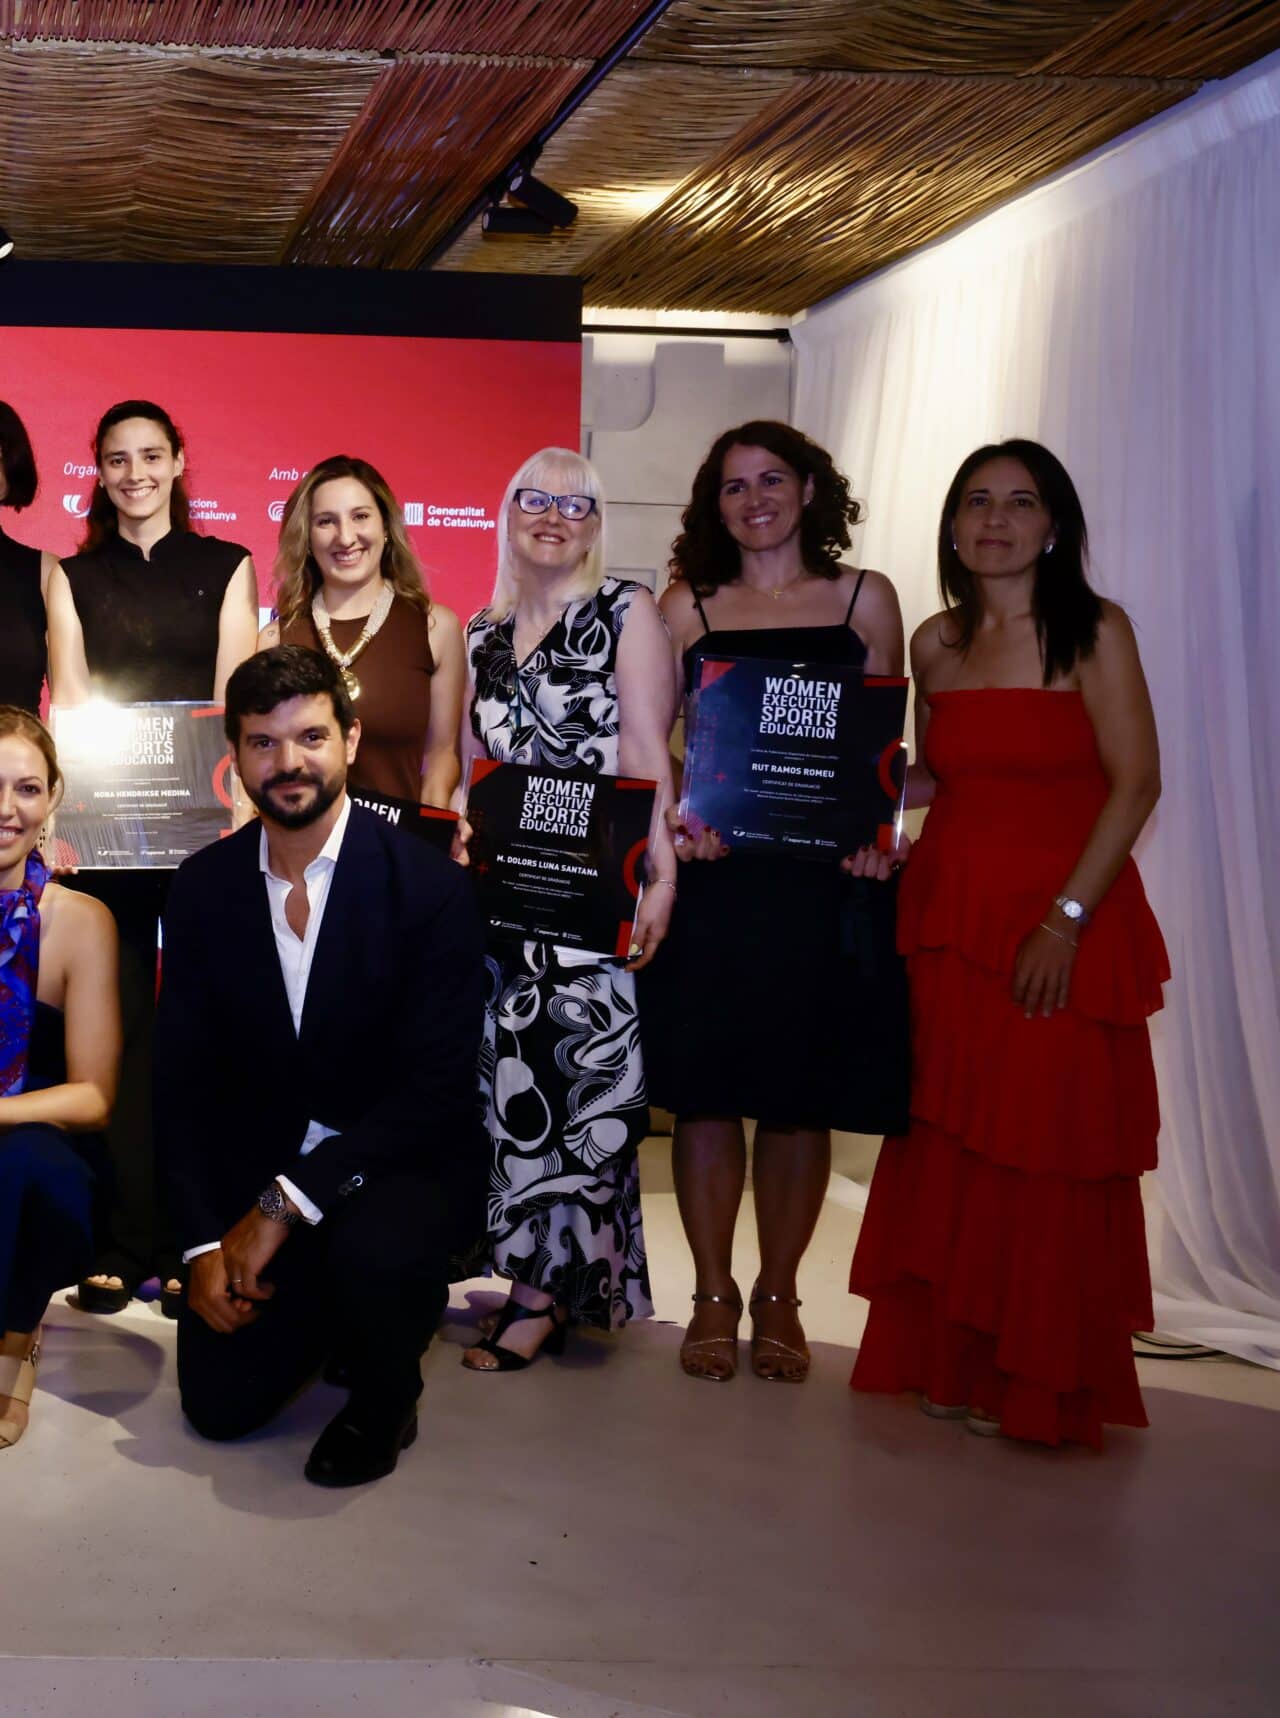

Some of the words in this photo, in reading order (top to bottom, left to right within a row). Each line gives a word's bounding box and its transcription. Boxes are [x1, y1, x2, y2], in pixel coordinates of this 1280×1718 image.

[268, 467, 299, 481] Amb
[427, 504, 485, 518] Generalitat
[427, 516, 441, 527] de
[442, 517, 495, 531] Catalunya
[764, 676, 841, 699] WOMEN
[762, 693, 840, 712] EXECUTIVE
[761, 706, 838, 728] SPORTS
[759, 721, 836, 740] EDUCATION
[132, 740, 174, 755] ORTS
[751, 762, 770, 772] RUT
[770, 765, 802, 775] RAMOS
[803, 768, 835, 778] ROMEU
[160, 789, 190, 797] MEDINA
[527, 775, 595, 800] WOMEN
[523, 791, 592, 811] EXECUTIVE
[522, 803, 590, 827] SPORTS
[519, 817, 588, 839] EDUCATION
[496, 854, 505, 863] M.
[507, 856, 537, 867] DOLORS
[539, 861, 560, 871] LUNA
[560, 864, 599, 877] SANTANA
